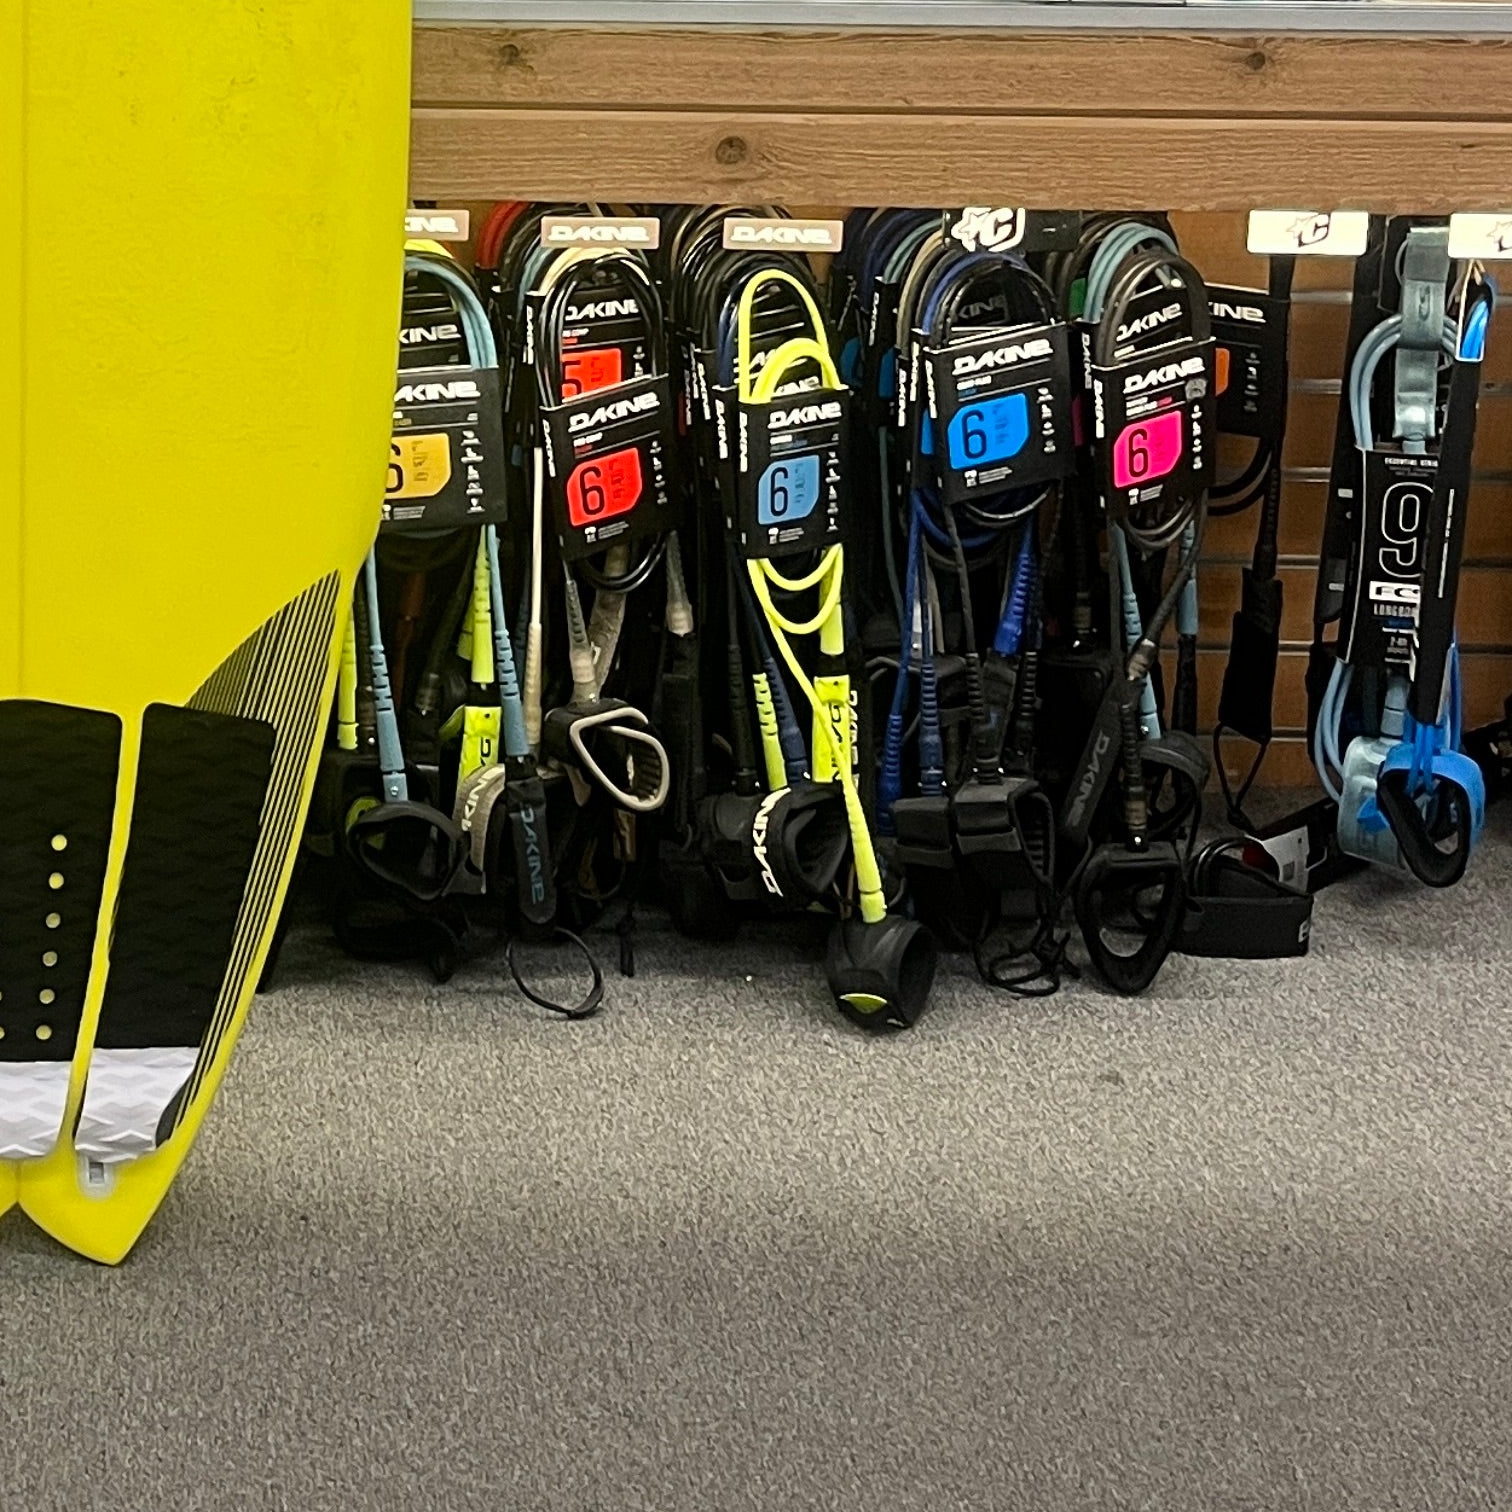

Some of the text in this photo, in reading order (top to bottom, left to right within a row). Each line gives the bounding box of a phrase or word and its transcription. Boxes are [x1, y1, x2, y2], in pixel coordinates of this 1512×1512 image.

[548, 226, 650, 242] DAKINE
[731, 225, 832, 245] DAKINE
[952, 338, 1054, 376] DAKINE
[1122, 356, 1206, 394] DAKINE
[394, 380, 481, 403] AKINE
[569, 392, 660, 432] DAKINE
[768, 401, 842, 430] DAKINE
[960, 409, 987, 460] 6
[1128, 428, 1149, 478] 6
[579, 465, 605, 515] 6
[769, 466, 789, 516] 6
[1378, 481, 1434, 578] 9
